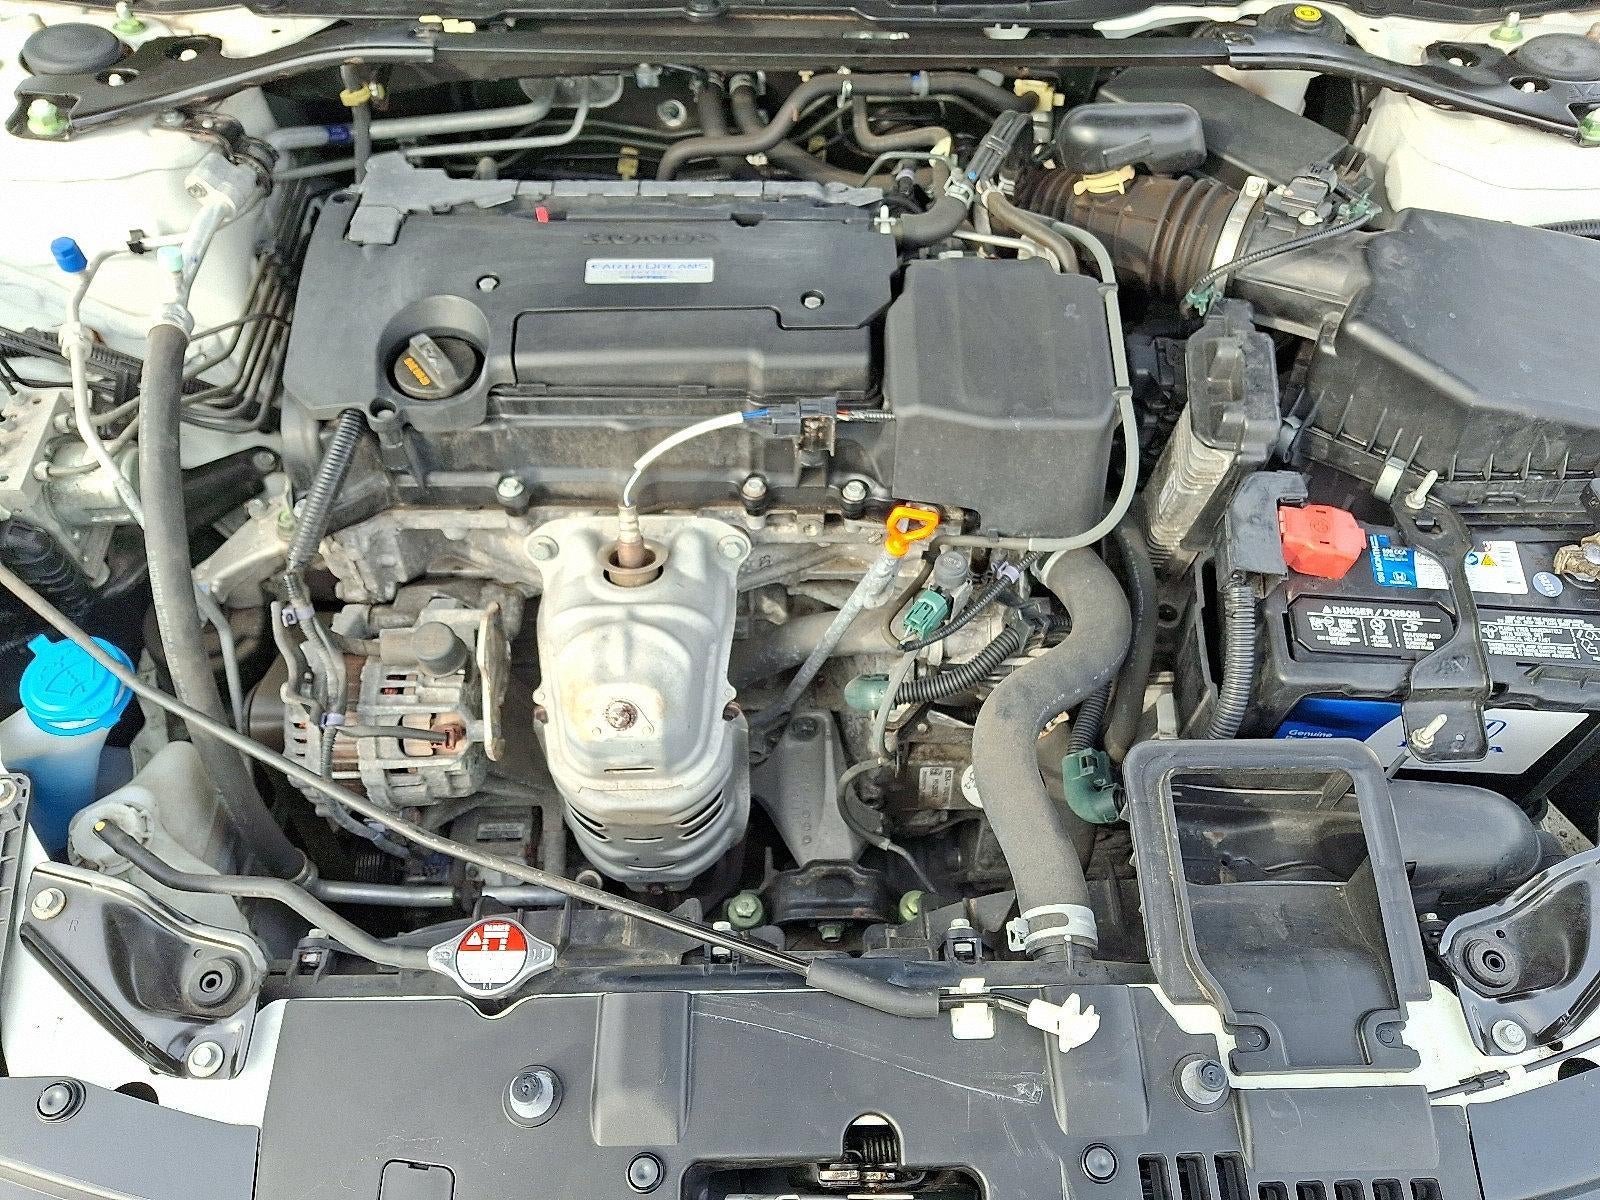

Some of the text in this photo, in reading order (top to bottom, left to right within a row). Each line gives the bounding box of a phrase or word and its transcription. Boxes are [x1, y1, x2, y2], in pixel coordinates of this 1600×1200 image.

[1332, 605, 1374, 617] DANGER
[1383, 608, 1421, 619] POISON
[1288, 729, 1334, 739] Genuine
